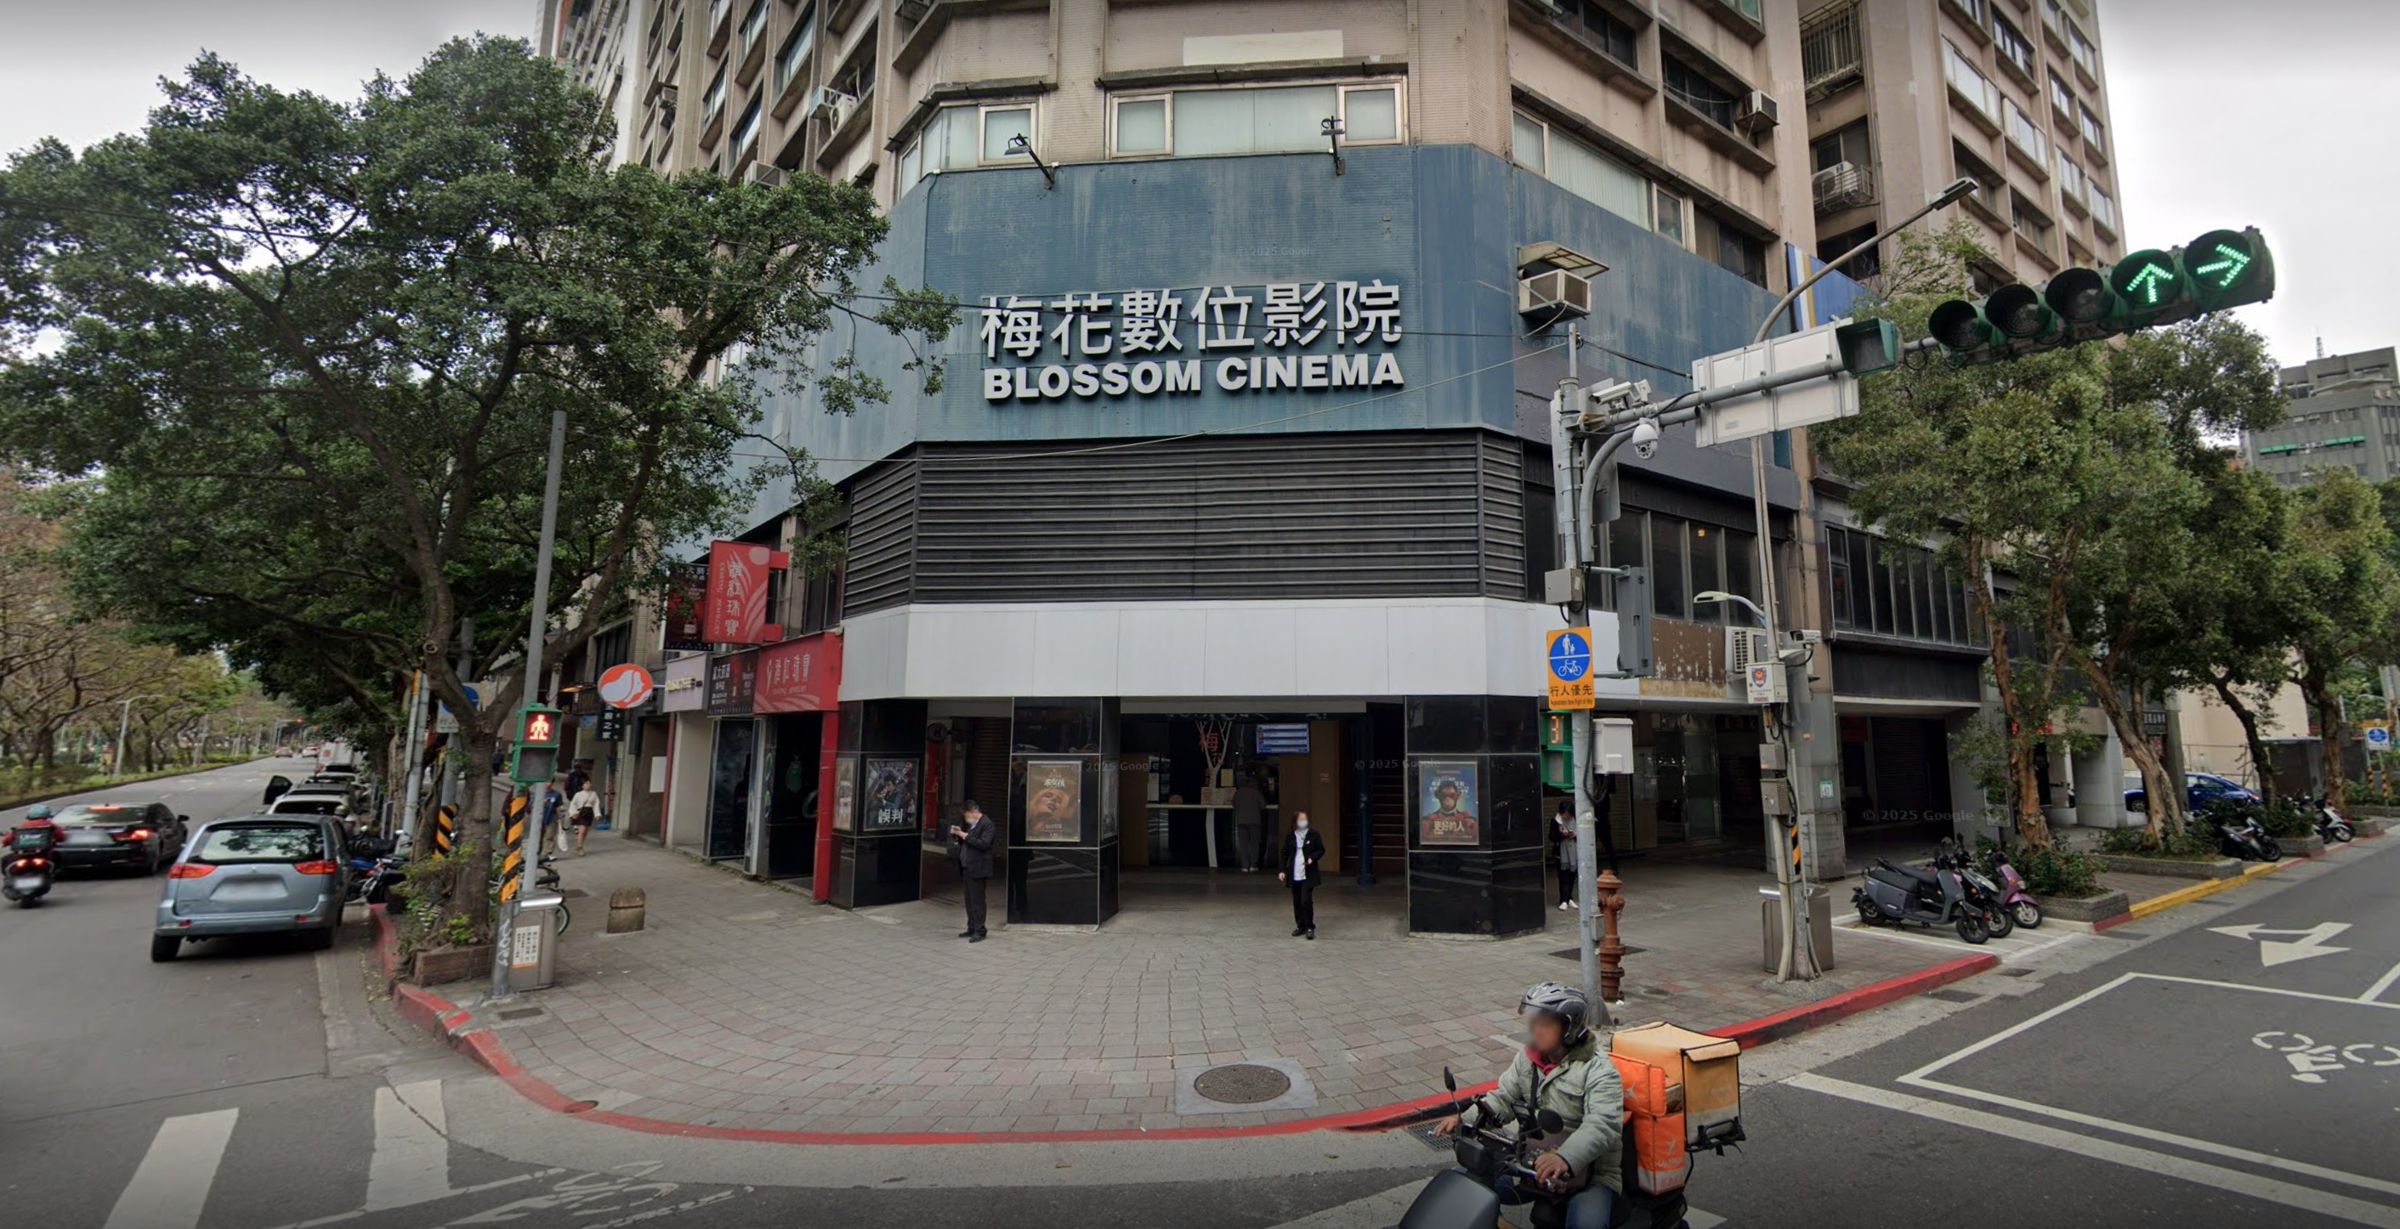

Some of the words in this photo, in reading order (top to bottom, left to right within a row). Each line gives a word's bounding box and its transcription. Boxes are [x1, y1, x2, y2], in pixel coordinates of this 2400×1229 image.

[981, 279, 1402, 358] 梅花數位影院
[984, 360, 1201, 400] BLOSSOM
[1217, 353, 1404, 391] CINEMA
[1550, 684, 1592, 696] 行人優先
[878, 808, 904, 824] 誤判
[1434, 820, 1465, 832] 更好的人
